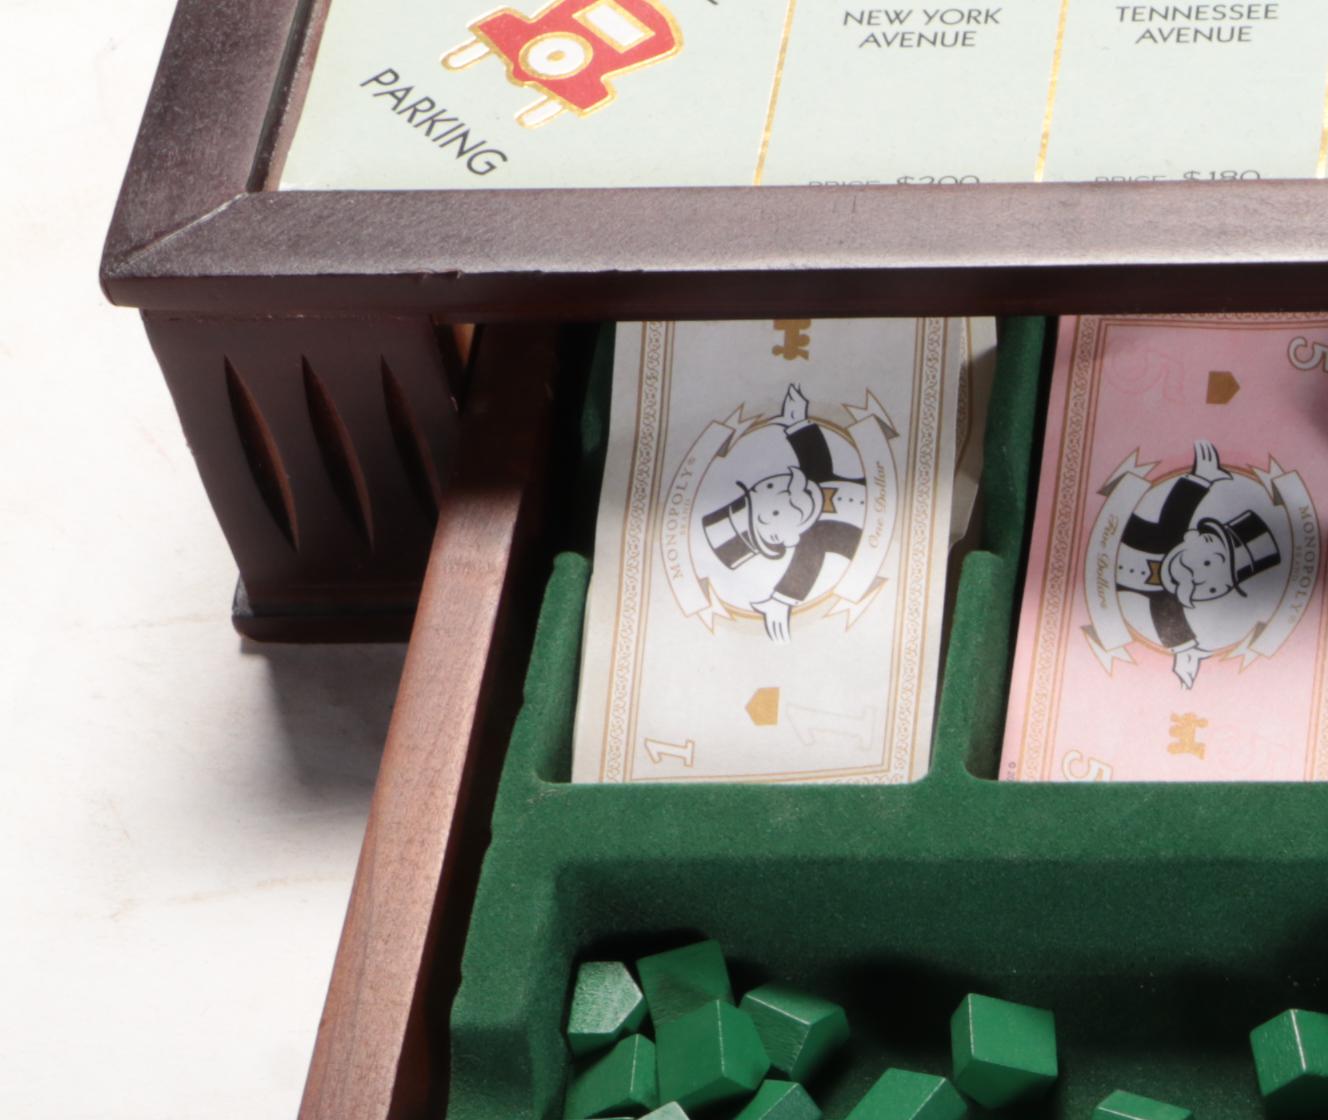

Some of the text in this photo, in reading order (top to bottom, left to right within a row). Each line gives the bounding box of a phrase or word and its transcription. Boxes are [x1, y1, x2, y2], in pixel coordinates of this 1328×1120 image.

[843, 8, 1003, 26] NEW YORK
[1115, 3, 1279, 22] TENNESSEE
[858, 30, 977, 49] AVENUE
[1134, 25, 1253, 45] AVENUE
[359, 67, 508, 176] PARKING
[644, 737, 696, 768] 1
[1061, 749, 1113, 781] 5
